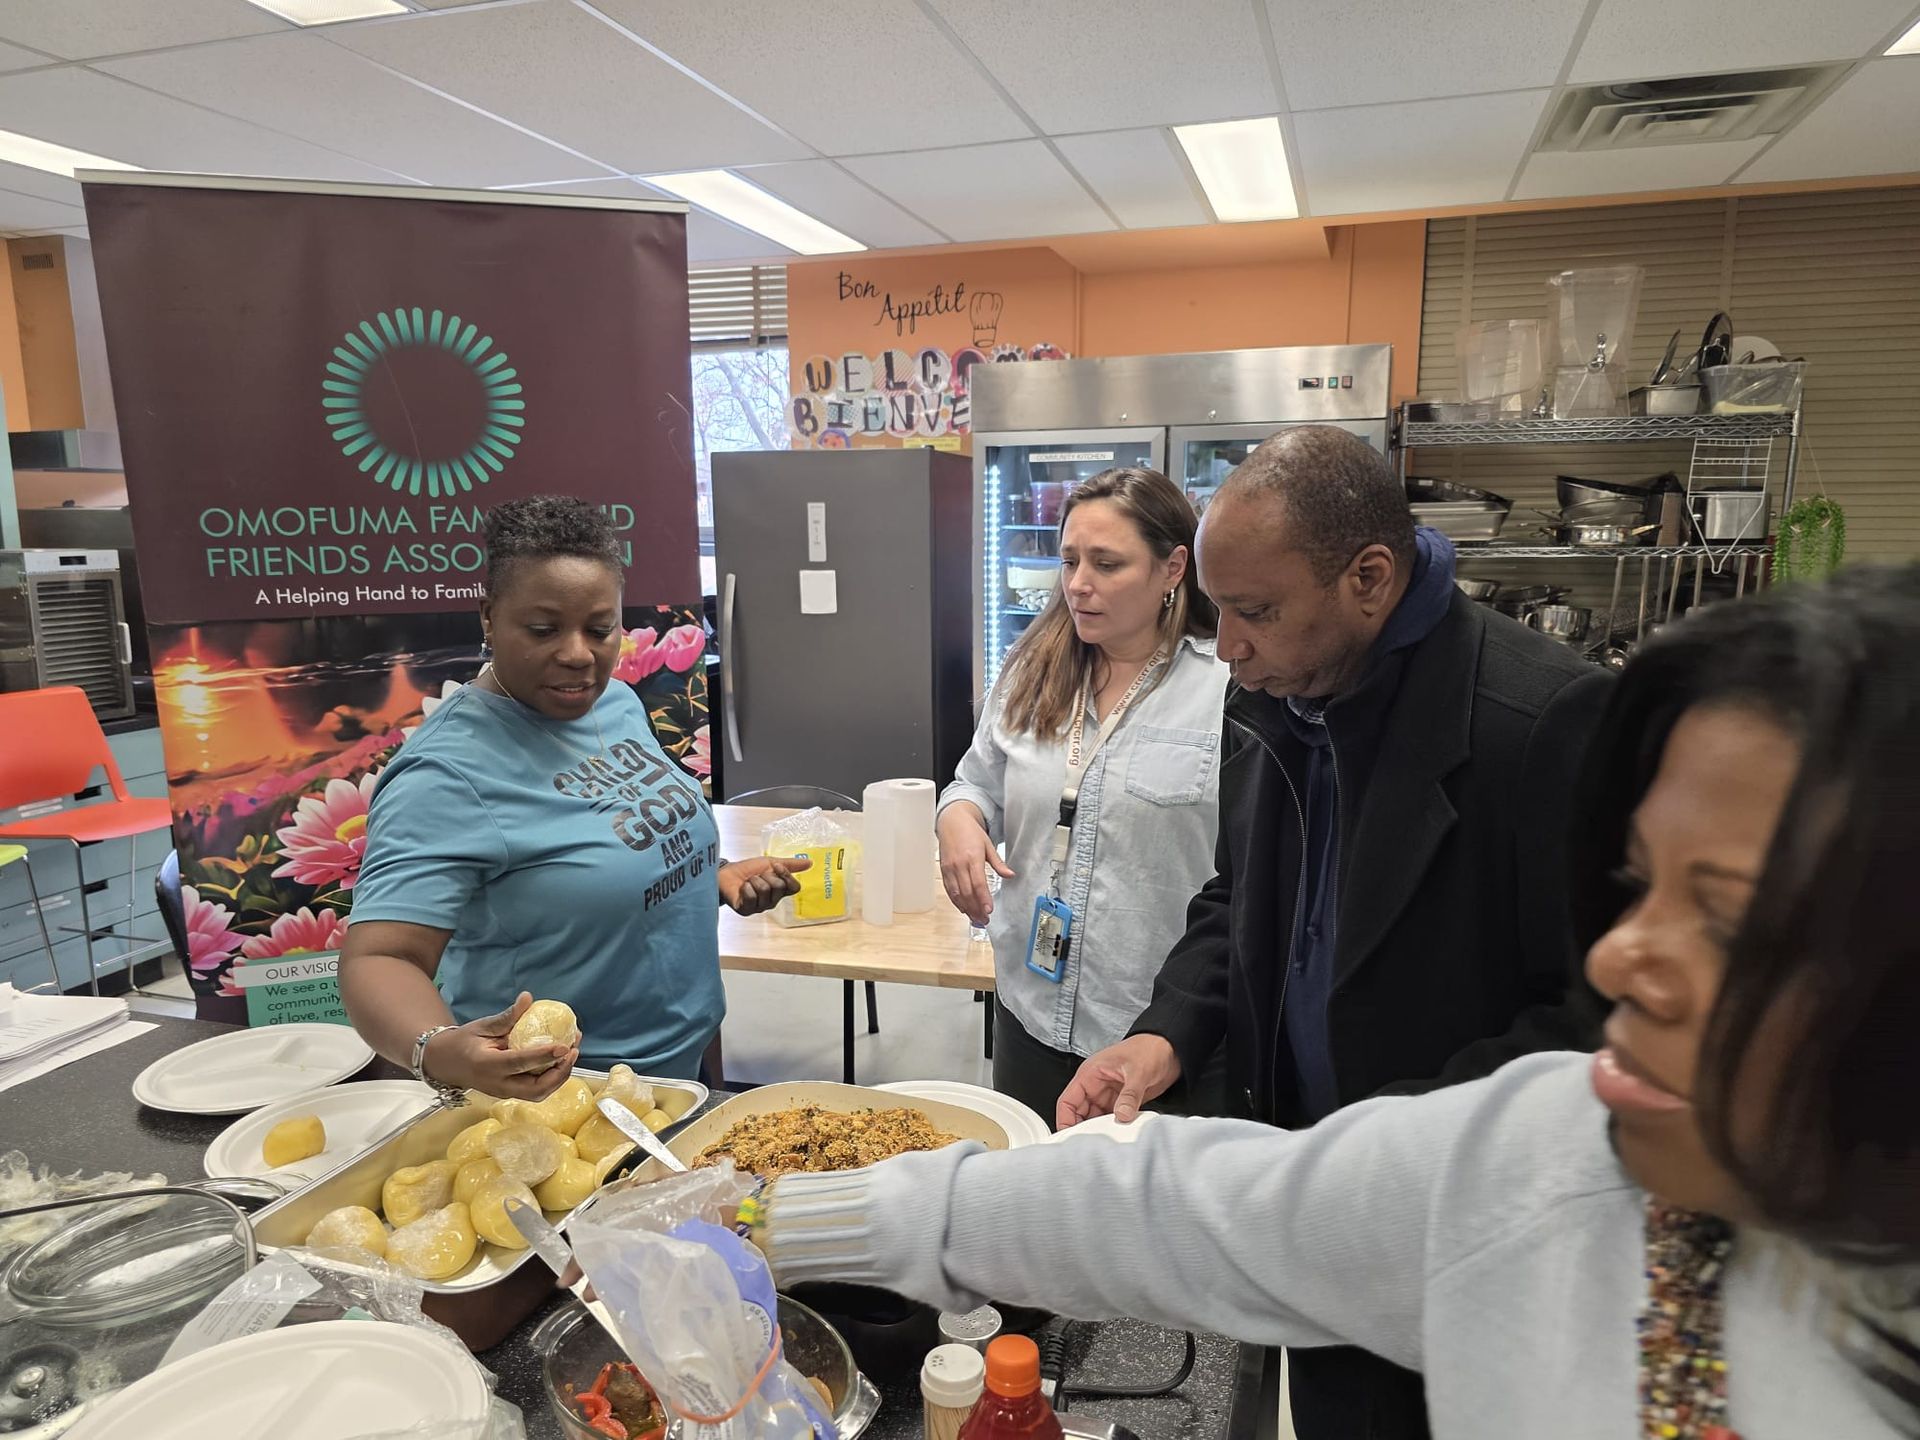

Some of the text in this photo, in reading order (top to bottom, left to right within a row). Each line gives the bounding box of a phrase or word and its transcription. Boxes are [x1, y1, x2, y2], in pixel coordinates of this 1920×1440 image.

[837, 272, 881, 300] Bon
[200, 506, 418, 538] OMOFUMA
[206, 544, 370, 577] FRIENDS
[255, 589, 271, 604] A
[276, 586, 349, 607] Helping
[355, 584, 405, 602] Hand
[410, 586, 428, 600] to
[618, 782, 642, 802] OF
[611, 784, 698, 851] GOD
[643, 864, 685, 911] PROUD
[265, 966, 299, 979] OUR
[265, 985, 288, 996] We
[293, 983, 315, 993] see
[319, 982, 328, 990] a
[267, 992, 340, 1011] community
[269, 1013, 282, 1025] of
[288, 1011, 319, 1023] love,
